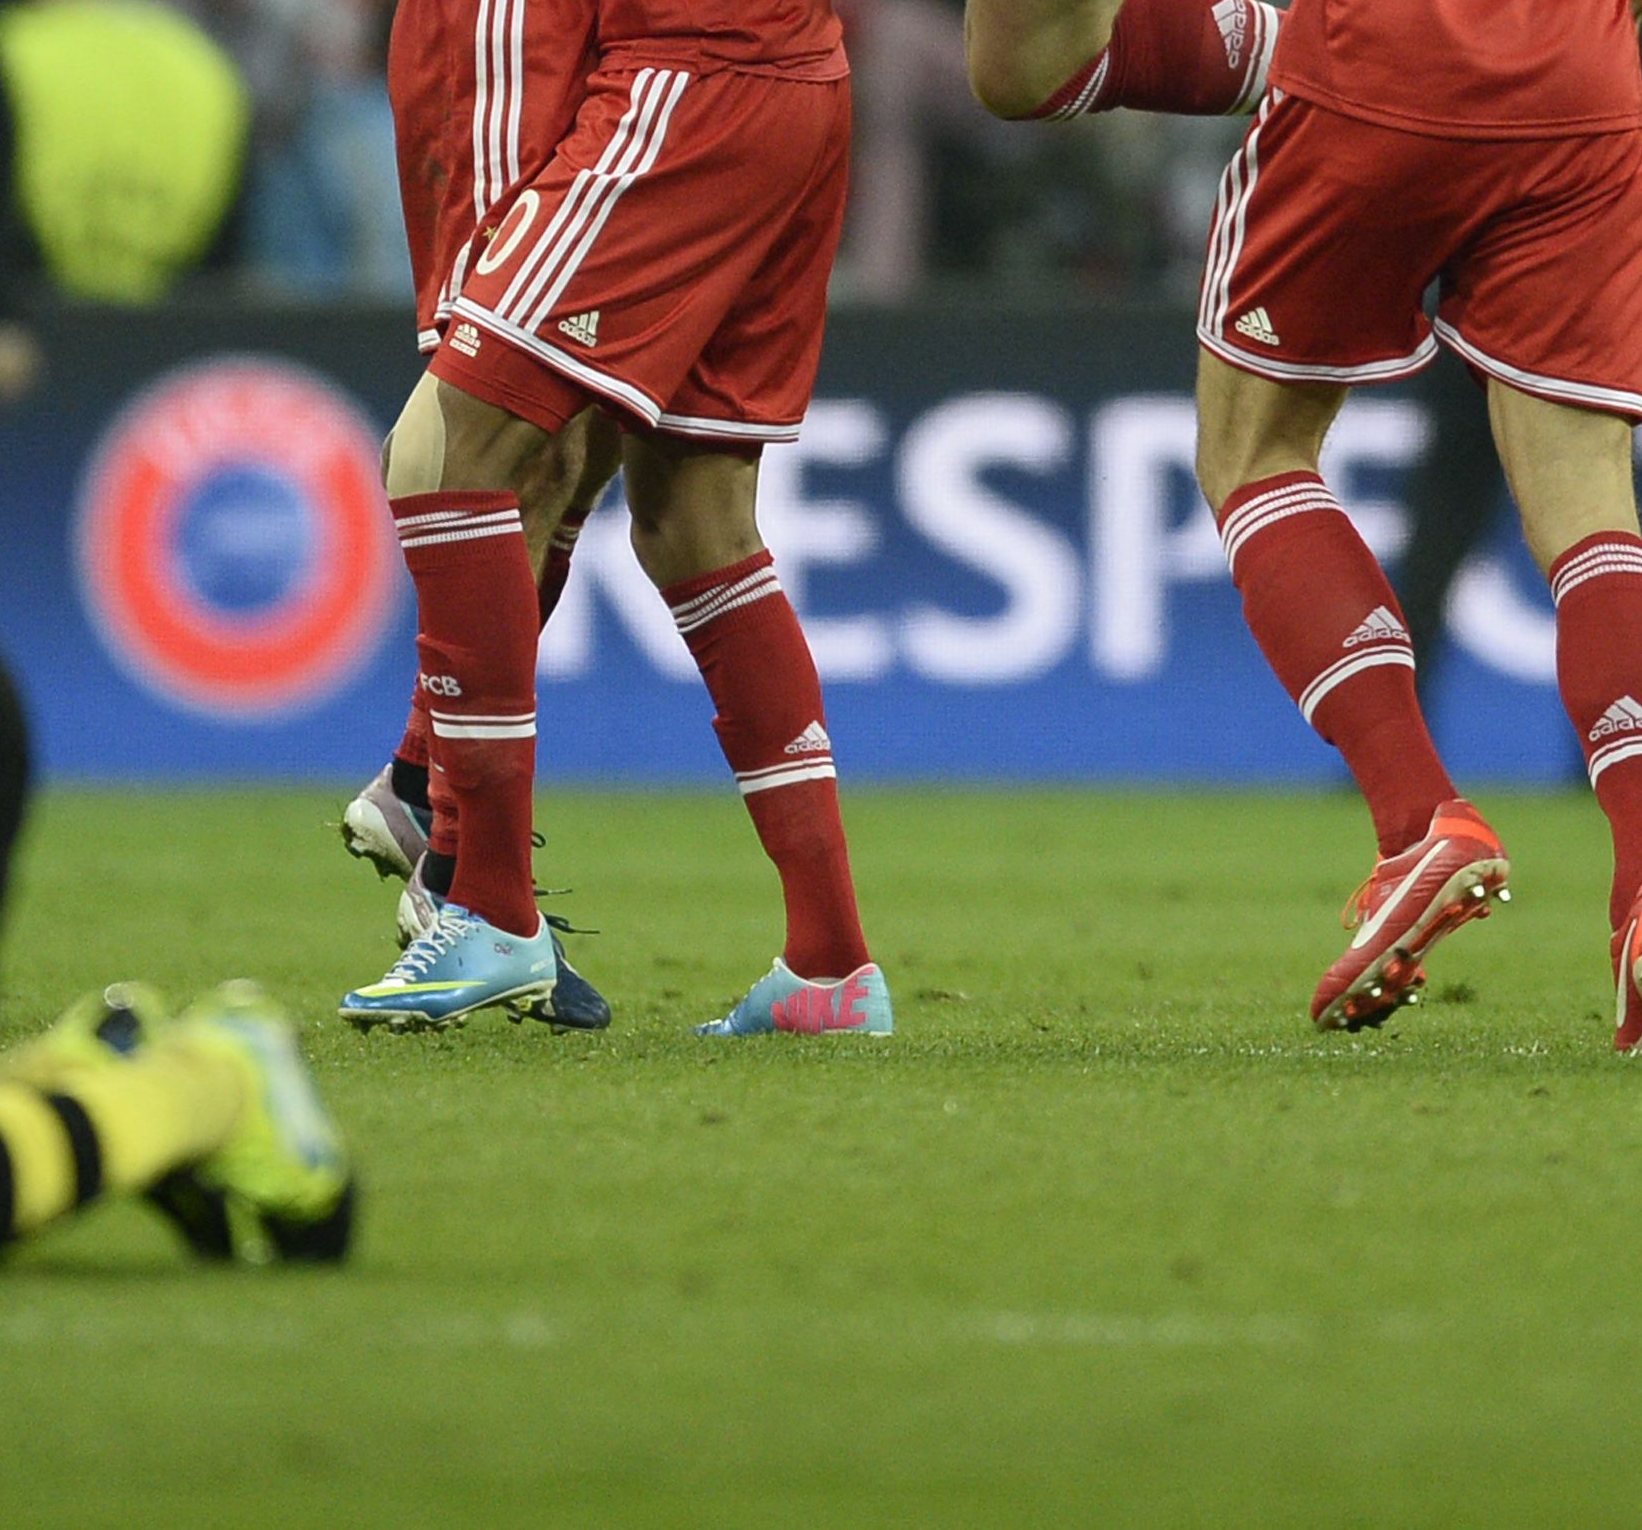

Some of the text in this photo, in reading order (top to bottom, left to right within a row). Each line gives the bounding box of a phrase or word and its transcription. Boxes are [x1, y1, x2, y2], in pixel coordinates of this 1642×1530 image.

[558, 321, 597, 348] adidas
[1235, 320, 1279, 346] adidas
[420, 672, 462, 696] FCB
